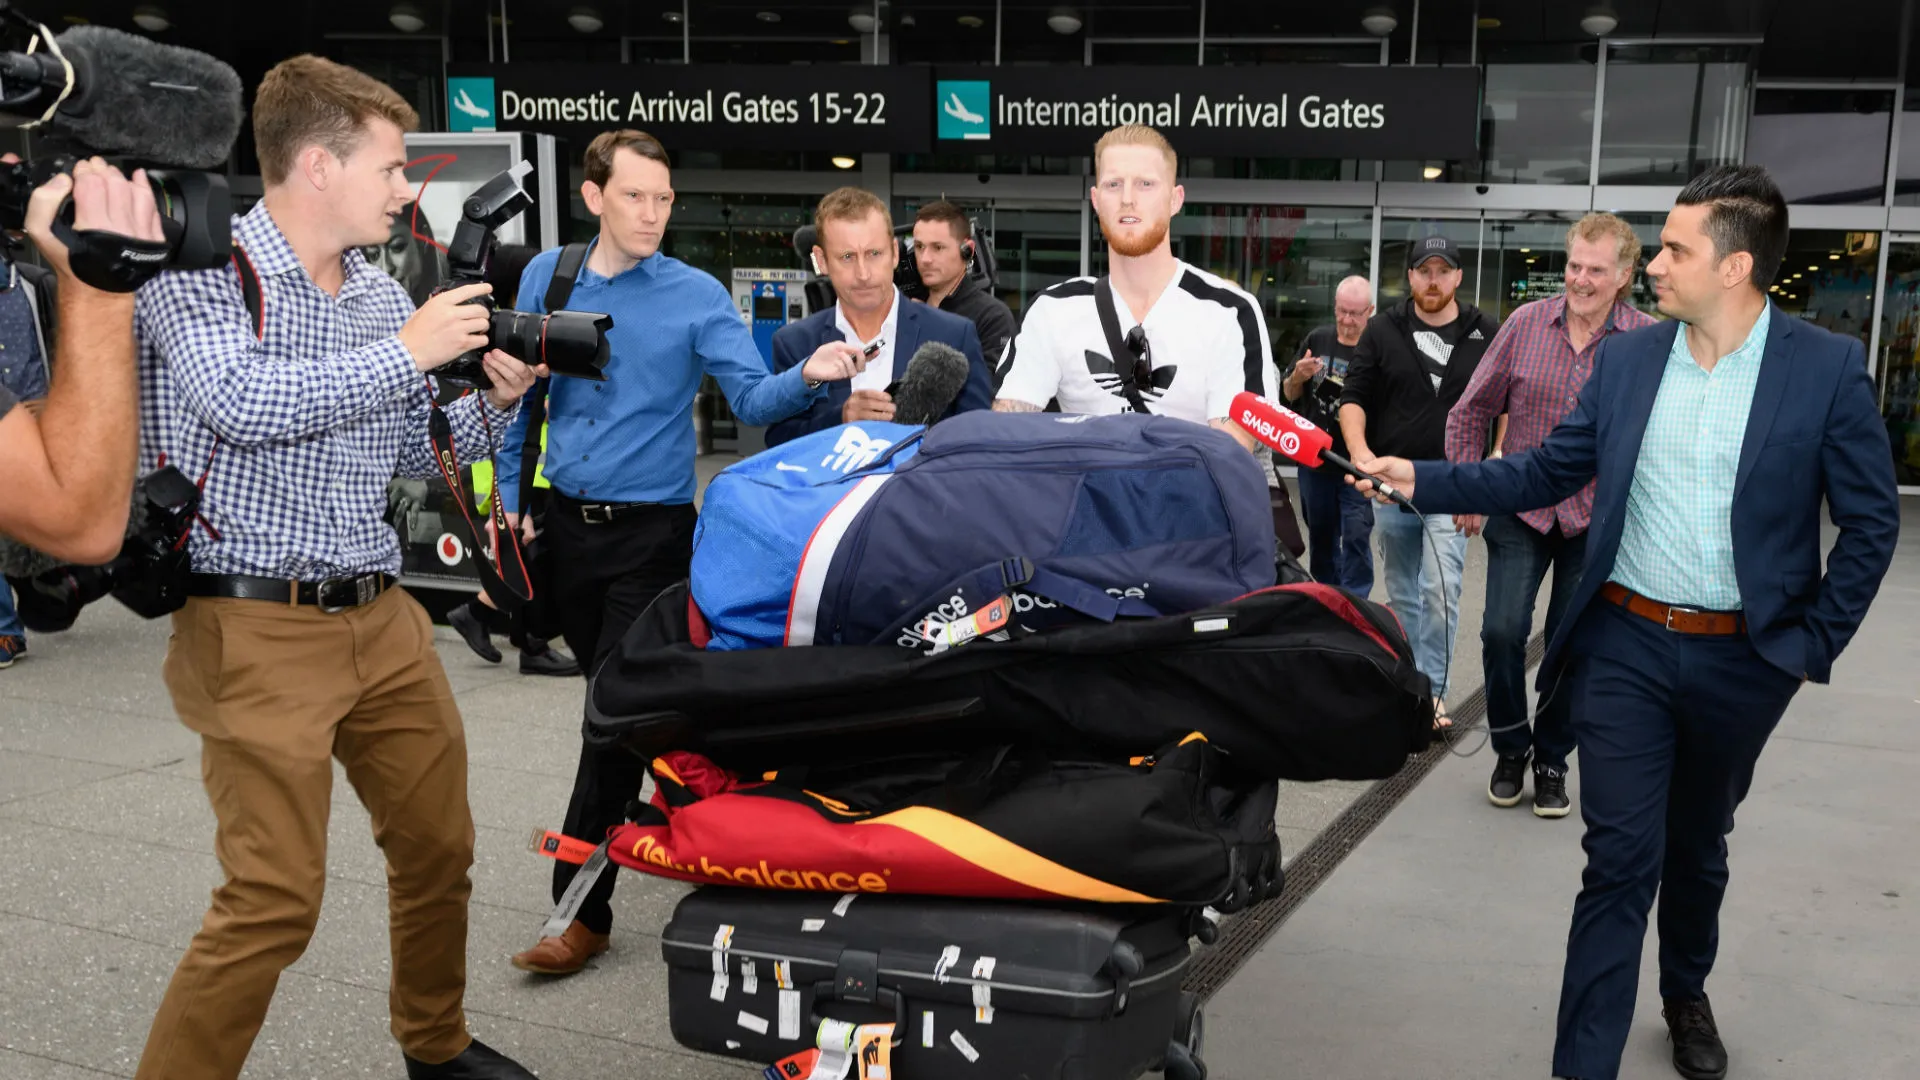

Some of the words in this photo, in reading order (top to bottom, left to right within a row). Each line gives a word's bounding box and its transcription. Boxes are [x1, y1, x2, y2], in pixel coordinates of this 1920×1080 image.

[502, 90, 620, 122] Domestic
[627, 89, 713, 122] Arrival
[722, 91, 799, 123] Gates
[809, 92, 886, 124] 15-22
[998, 92, 1181, 127] International
[1190, 93, 1288, 128] Arrival
[1298, 95, 1385, 128] Gates
[1242, 409, 1282, 443] news
[896, 594, 968, 648] alance
